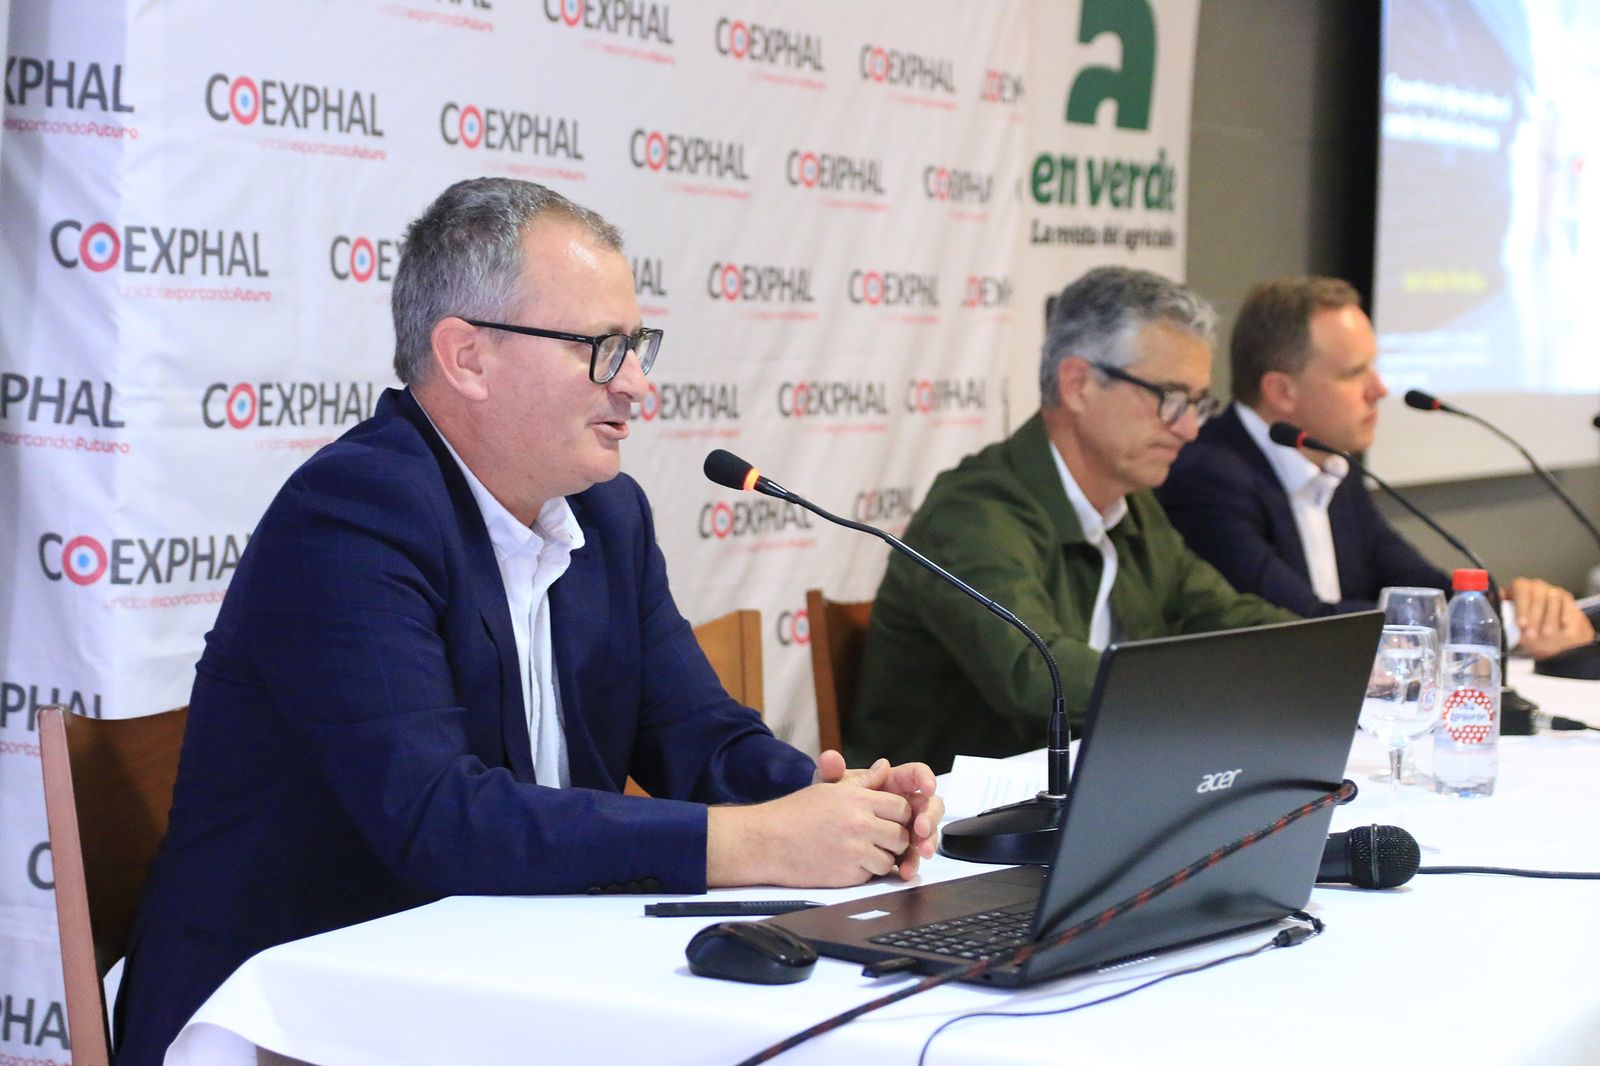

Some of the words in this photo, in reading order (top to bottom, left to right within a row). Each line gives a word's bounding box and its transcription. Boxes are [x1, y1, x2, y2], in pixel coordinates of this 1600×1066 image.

[715, 17, 824, 72] COEXPHAL
[205, 73, 384, 137] COEXPHAL
[440, 101, 584, 160] COEXPHAL
[630, 128, 749, 180] COEXPHAL
[1031, 151, 1077, 205] en
[50, 219, 269, 278] COEXPHAL
[629, 382, 741, 423] OEXPHAL
[38, 531, 251, 586] COEXPHA
[1197, 768, 1243, 793] acer
